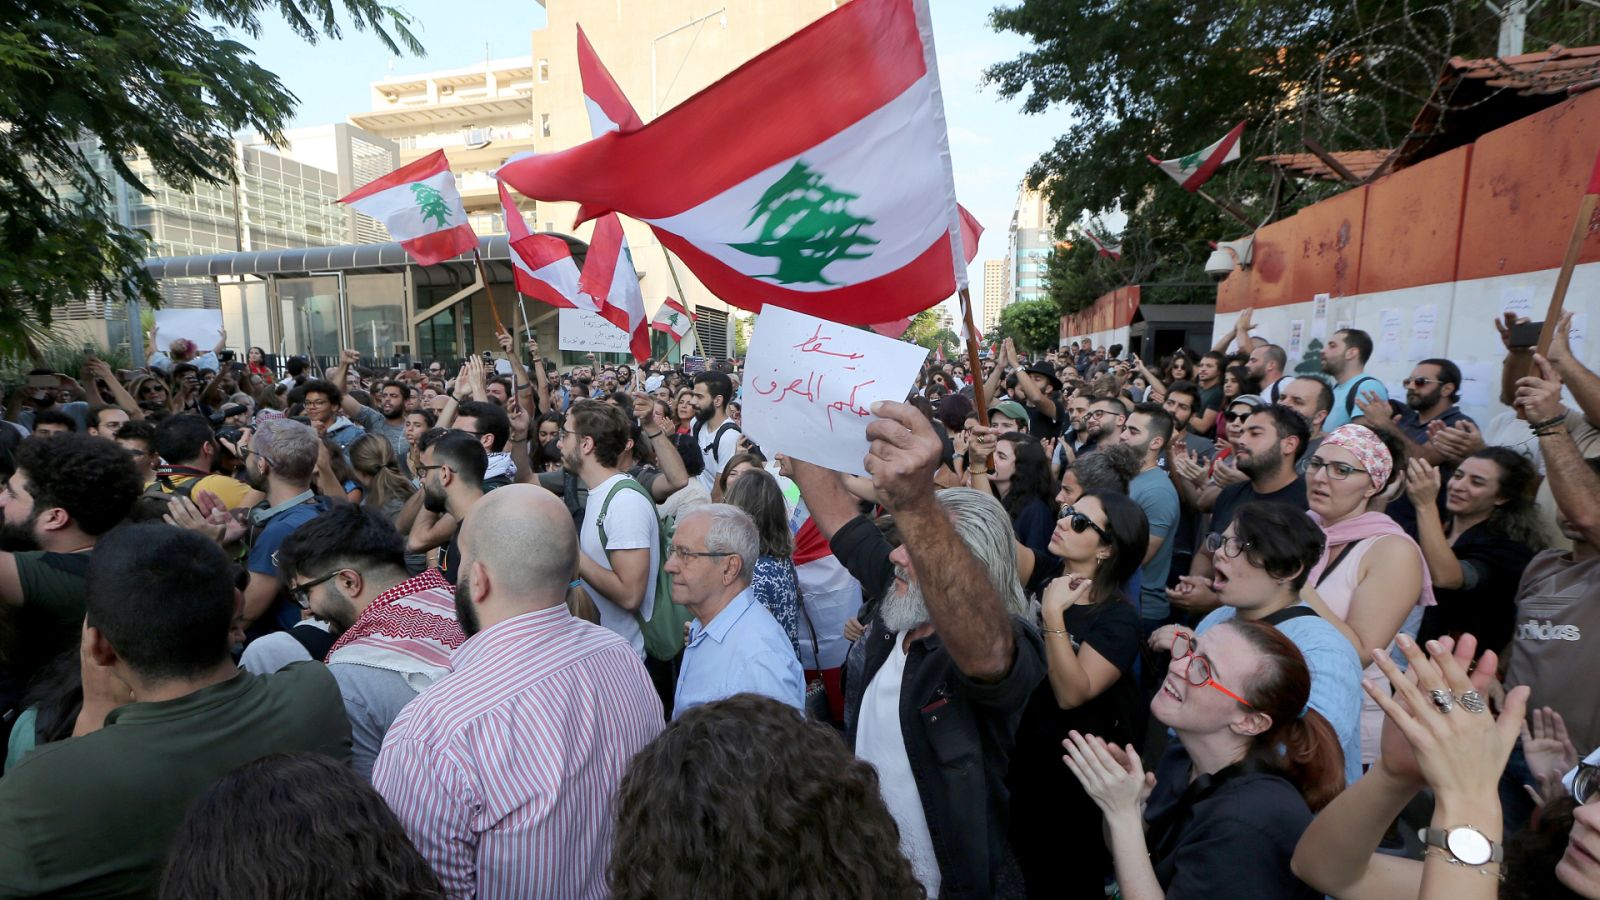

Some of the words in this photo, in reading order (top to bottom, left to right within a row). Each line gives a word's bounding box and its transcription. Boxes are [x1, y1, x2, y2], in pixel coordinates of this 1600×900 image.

[792, 323, 865, 370] يسقط
[751, 368, 824, 403] المصرف
[827, 379, 876, 433] حكم
